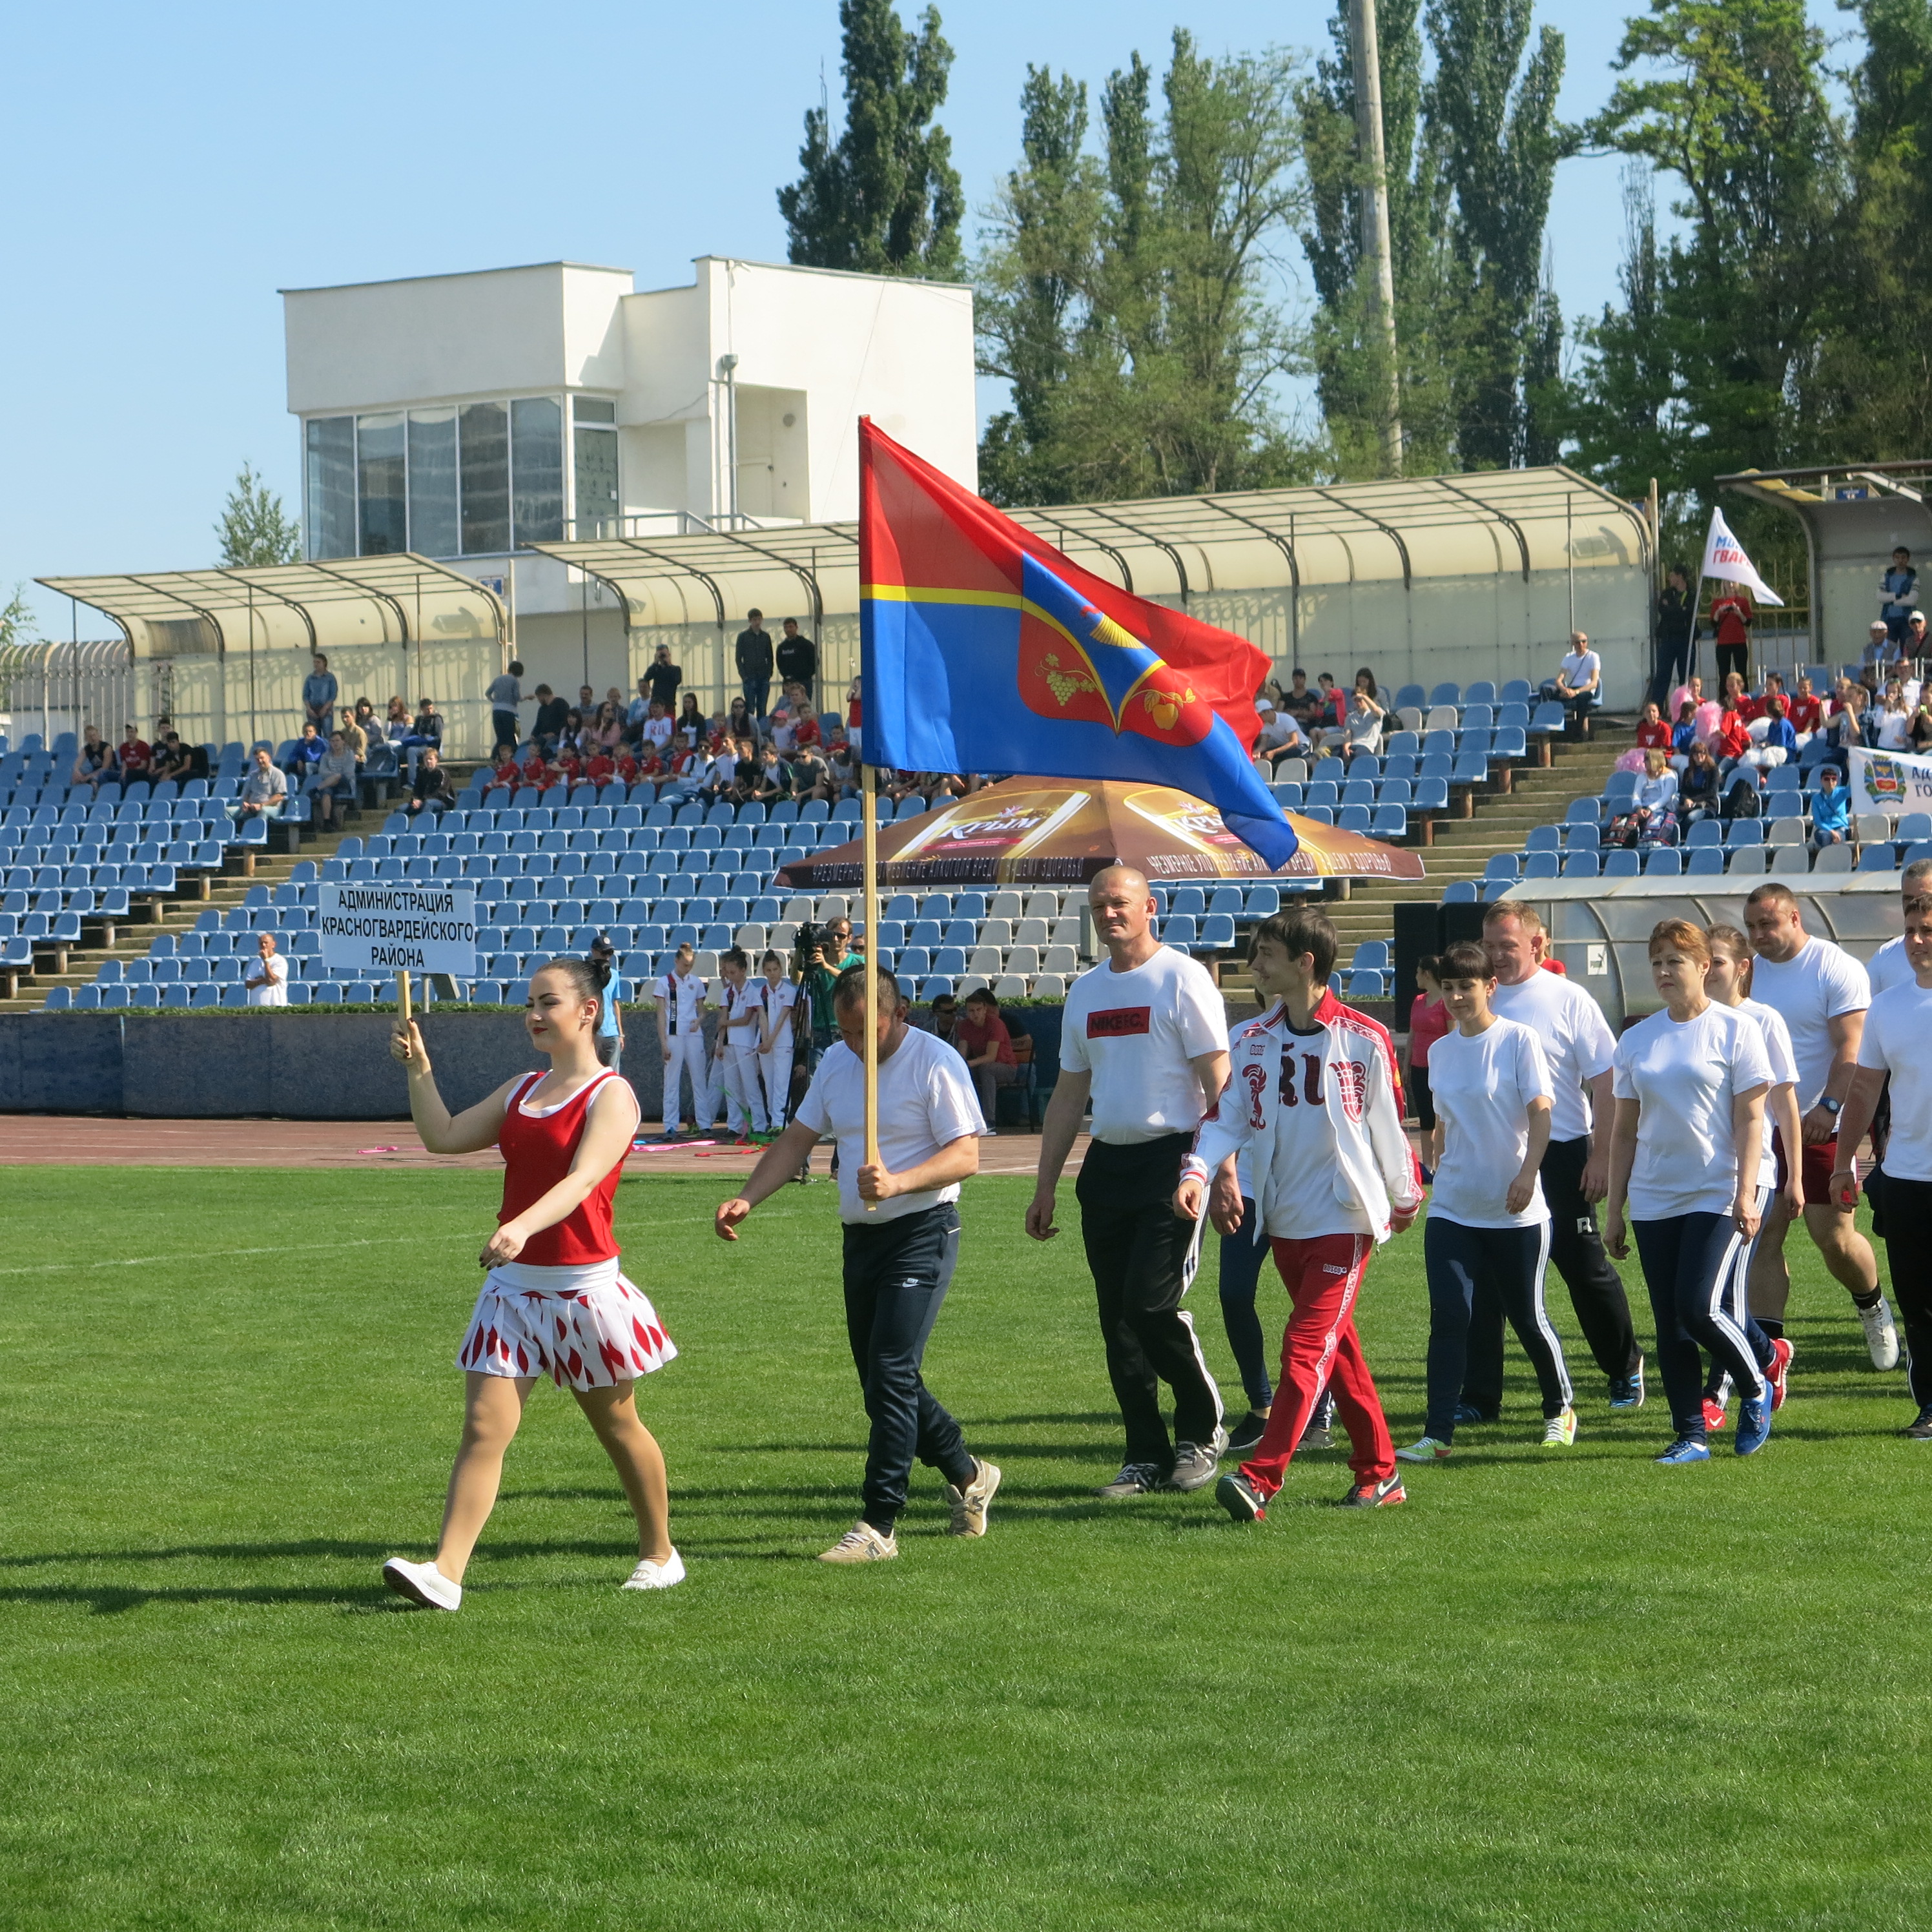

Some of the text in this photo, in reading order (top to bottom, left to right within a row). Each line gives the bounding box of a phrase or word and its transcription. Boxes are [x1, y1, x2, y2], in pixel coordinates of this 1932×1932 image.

[813, 862, 863, 882] ЧРЕЗМЕРНОЕ
[876, 859, 927, 879] ОТРЕБЛЕНИЕ
[929, 858, 971, 878] АЛКОГОЛЯ
[1042, 857, 1084, 881] ЗДОРОВЬЮ
[1146, 855, 1198, 874] ЧРЕЗМЕРНОЕ
[1193, 853, 1253, 872] УПОТРЕБЛЕНИЕ
[1350, 852, 1392, 873] ЗДОРОВЬЮ
[338, 889, 454, 915] АДМИНИСТРАЦИЯ
[322, 916, 473, 942] КРАСНОГВАРДЕЙСКОГО
[371, 942, 425, 967] РАЙОНА
